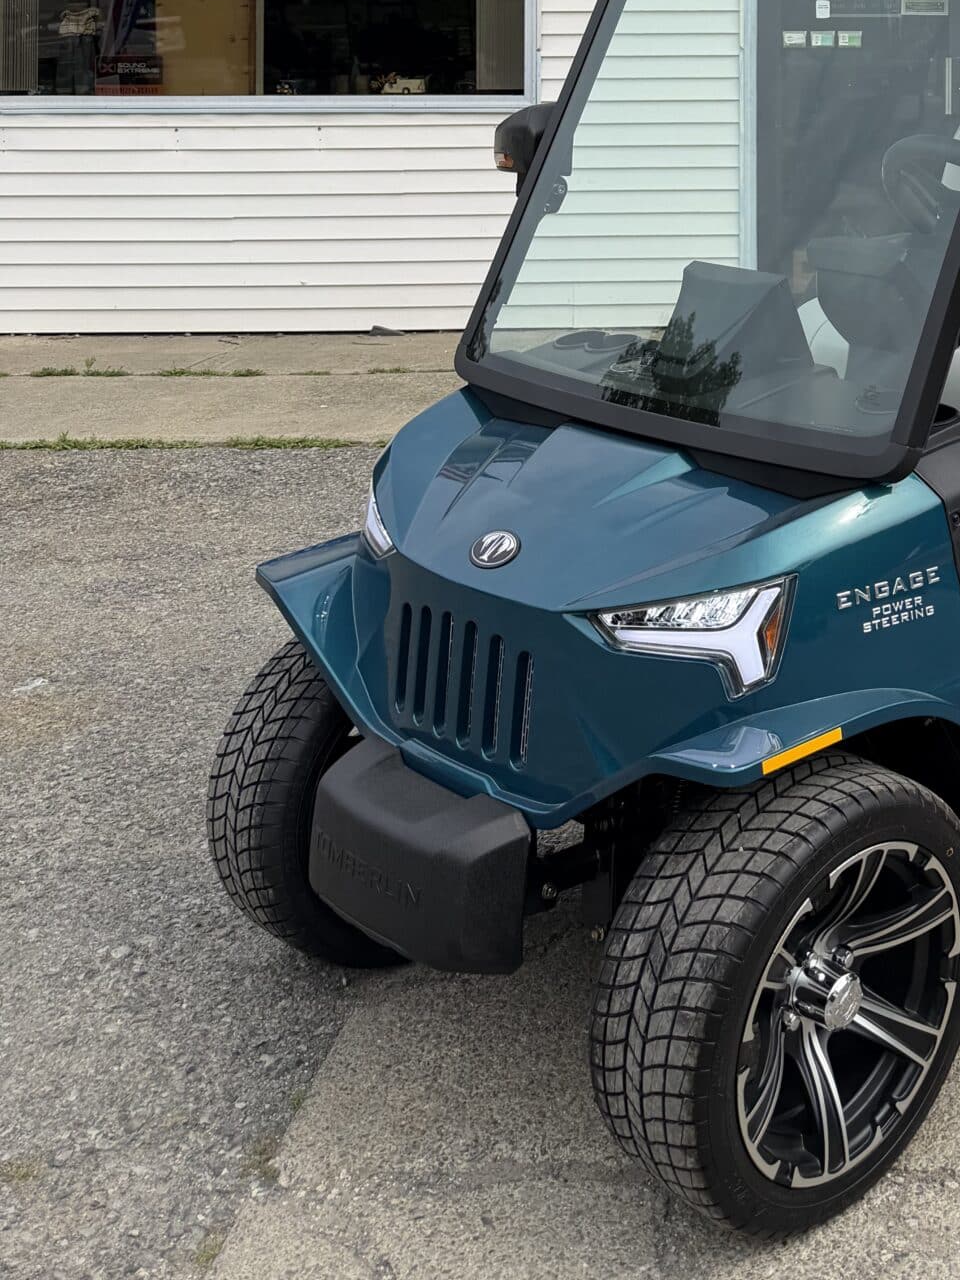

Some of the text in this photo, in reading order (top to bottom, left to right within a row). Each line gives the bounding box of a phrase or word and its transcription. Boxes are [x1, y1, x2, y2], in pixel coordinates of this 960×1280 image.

[836, 566, 941, 610] ENGAGE
[863, 605, 935, 633] STEERING
[872, 596, 923, 619] POWER
